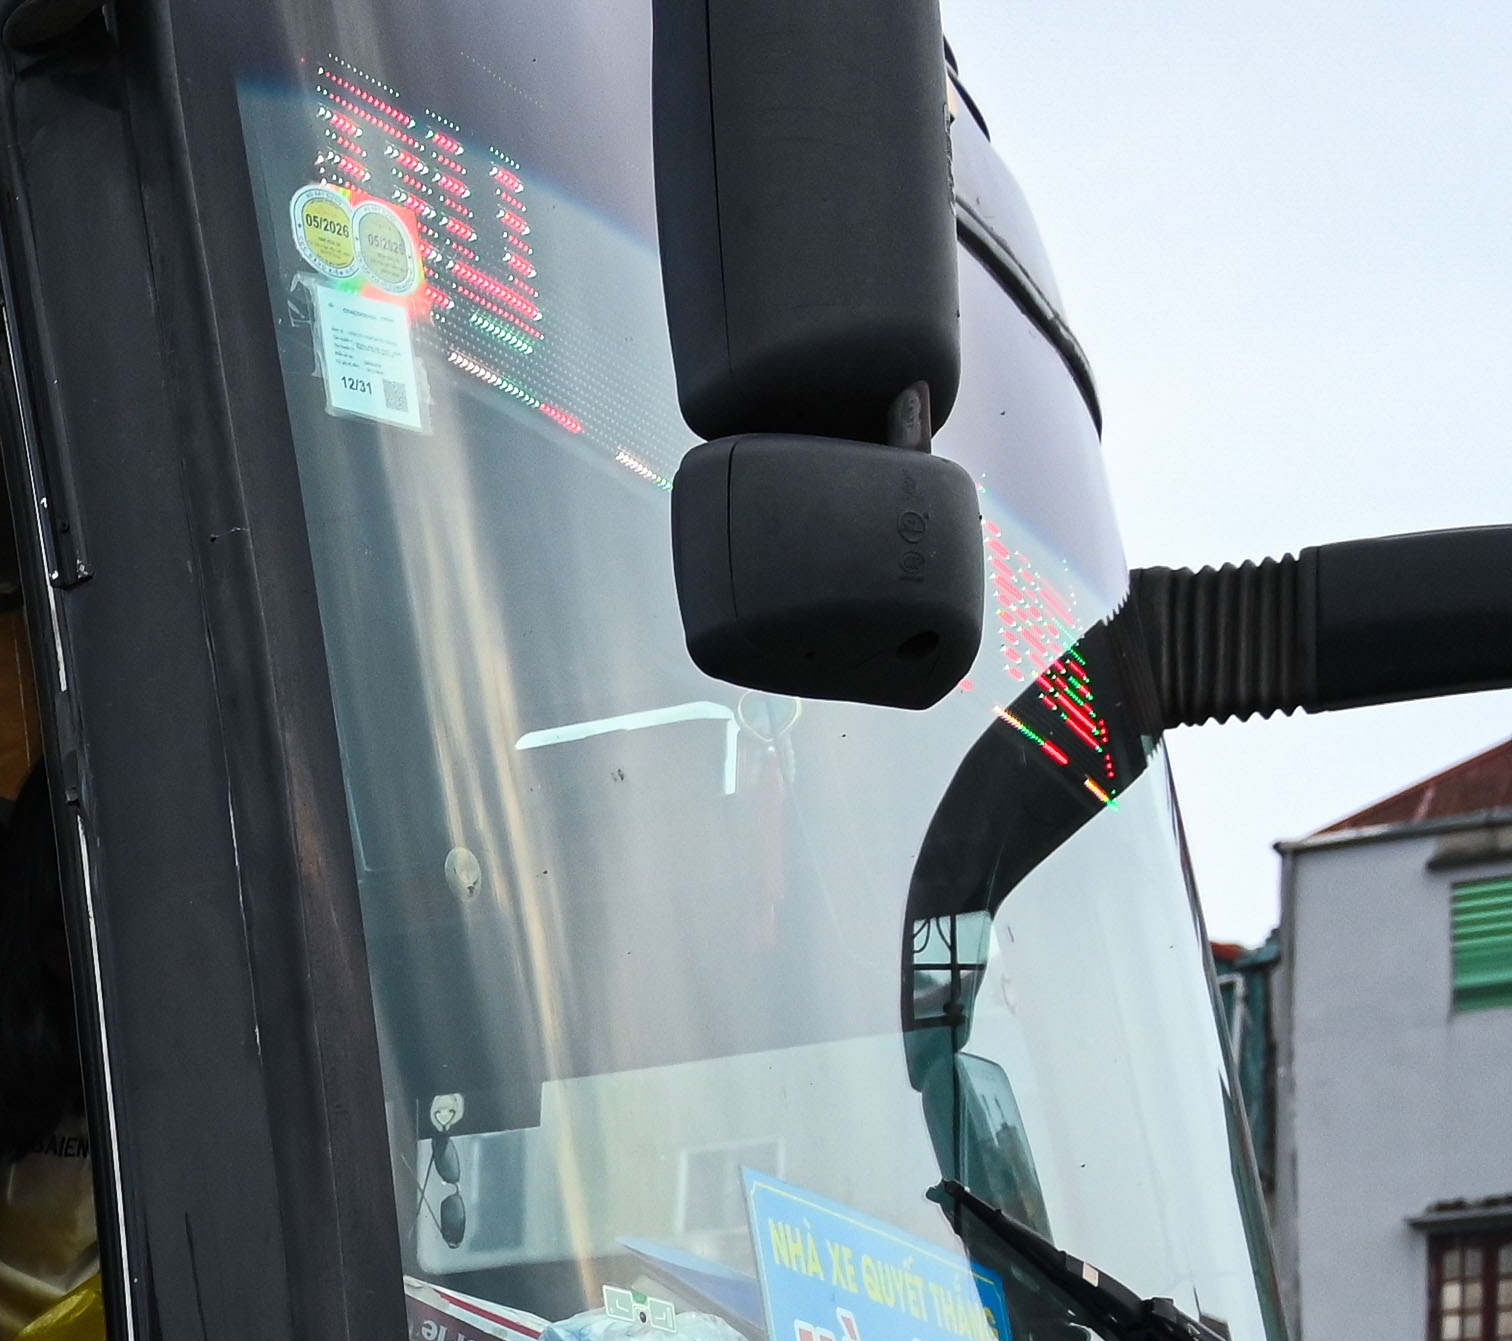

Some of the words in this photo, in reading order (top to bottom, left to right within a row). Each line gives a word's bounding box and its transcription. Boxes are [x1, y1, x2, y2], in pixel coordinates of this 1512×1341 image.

[305, 213, 350, 238] 05/2026
[342, 376, 372, 395] 12/31
[770, 1217, 824, 1281] NHÀ
[826, 1240, 859, 1294] XE
[862, 1254, 928, 1322] QUYẾT
